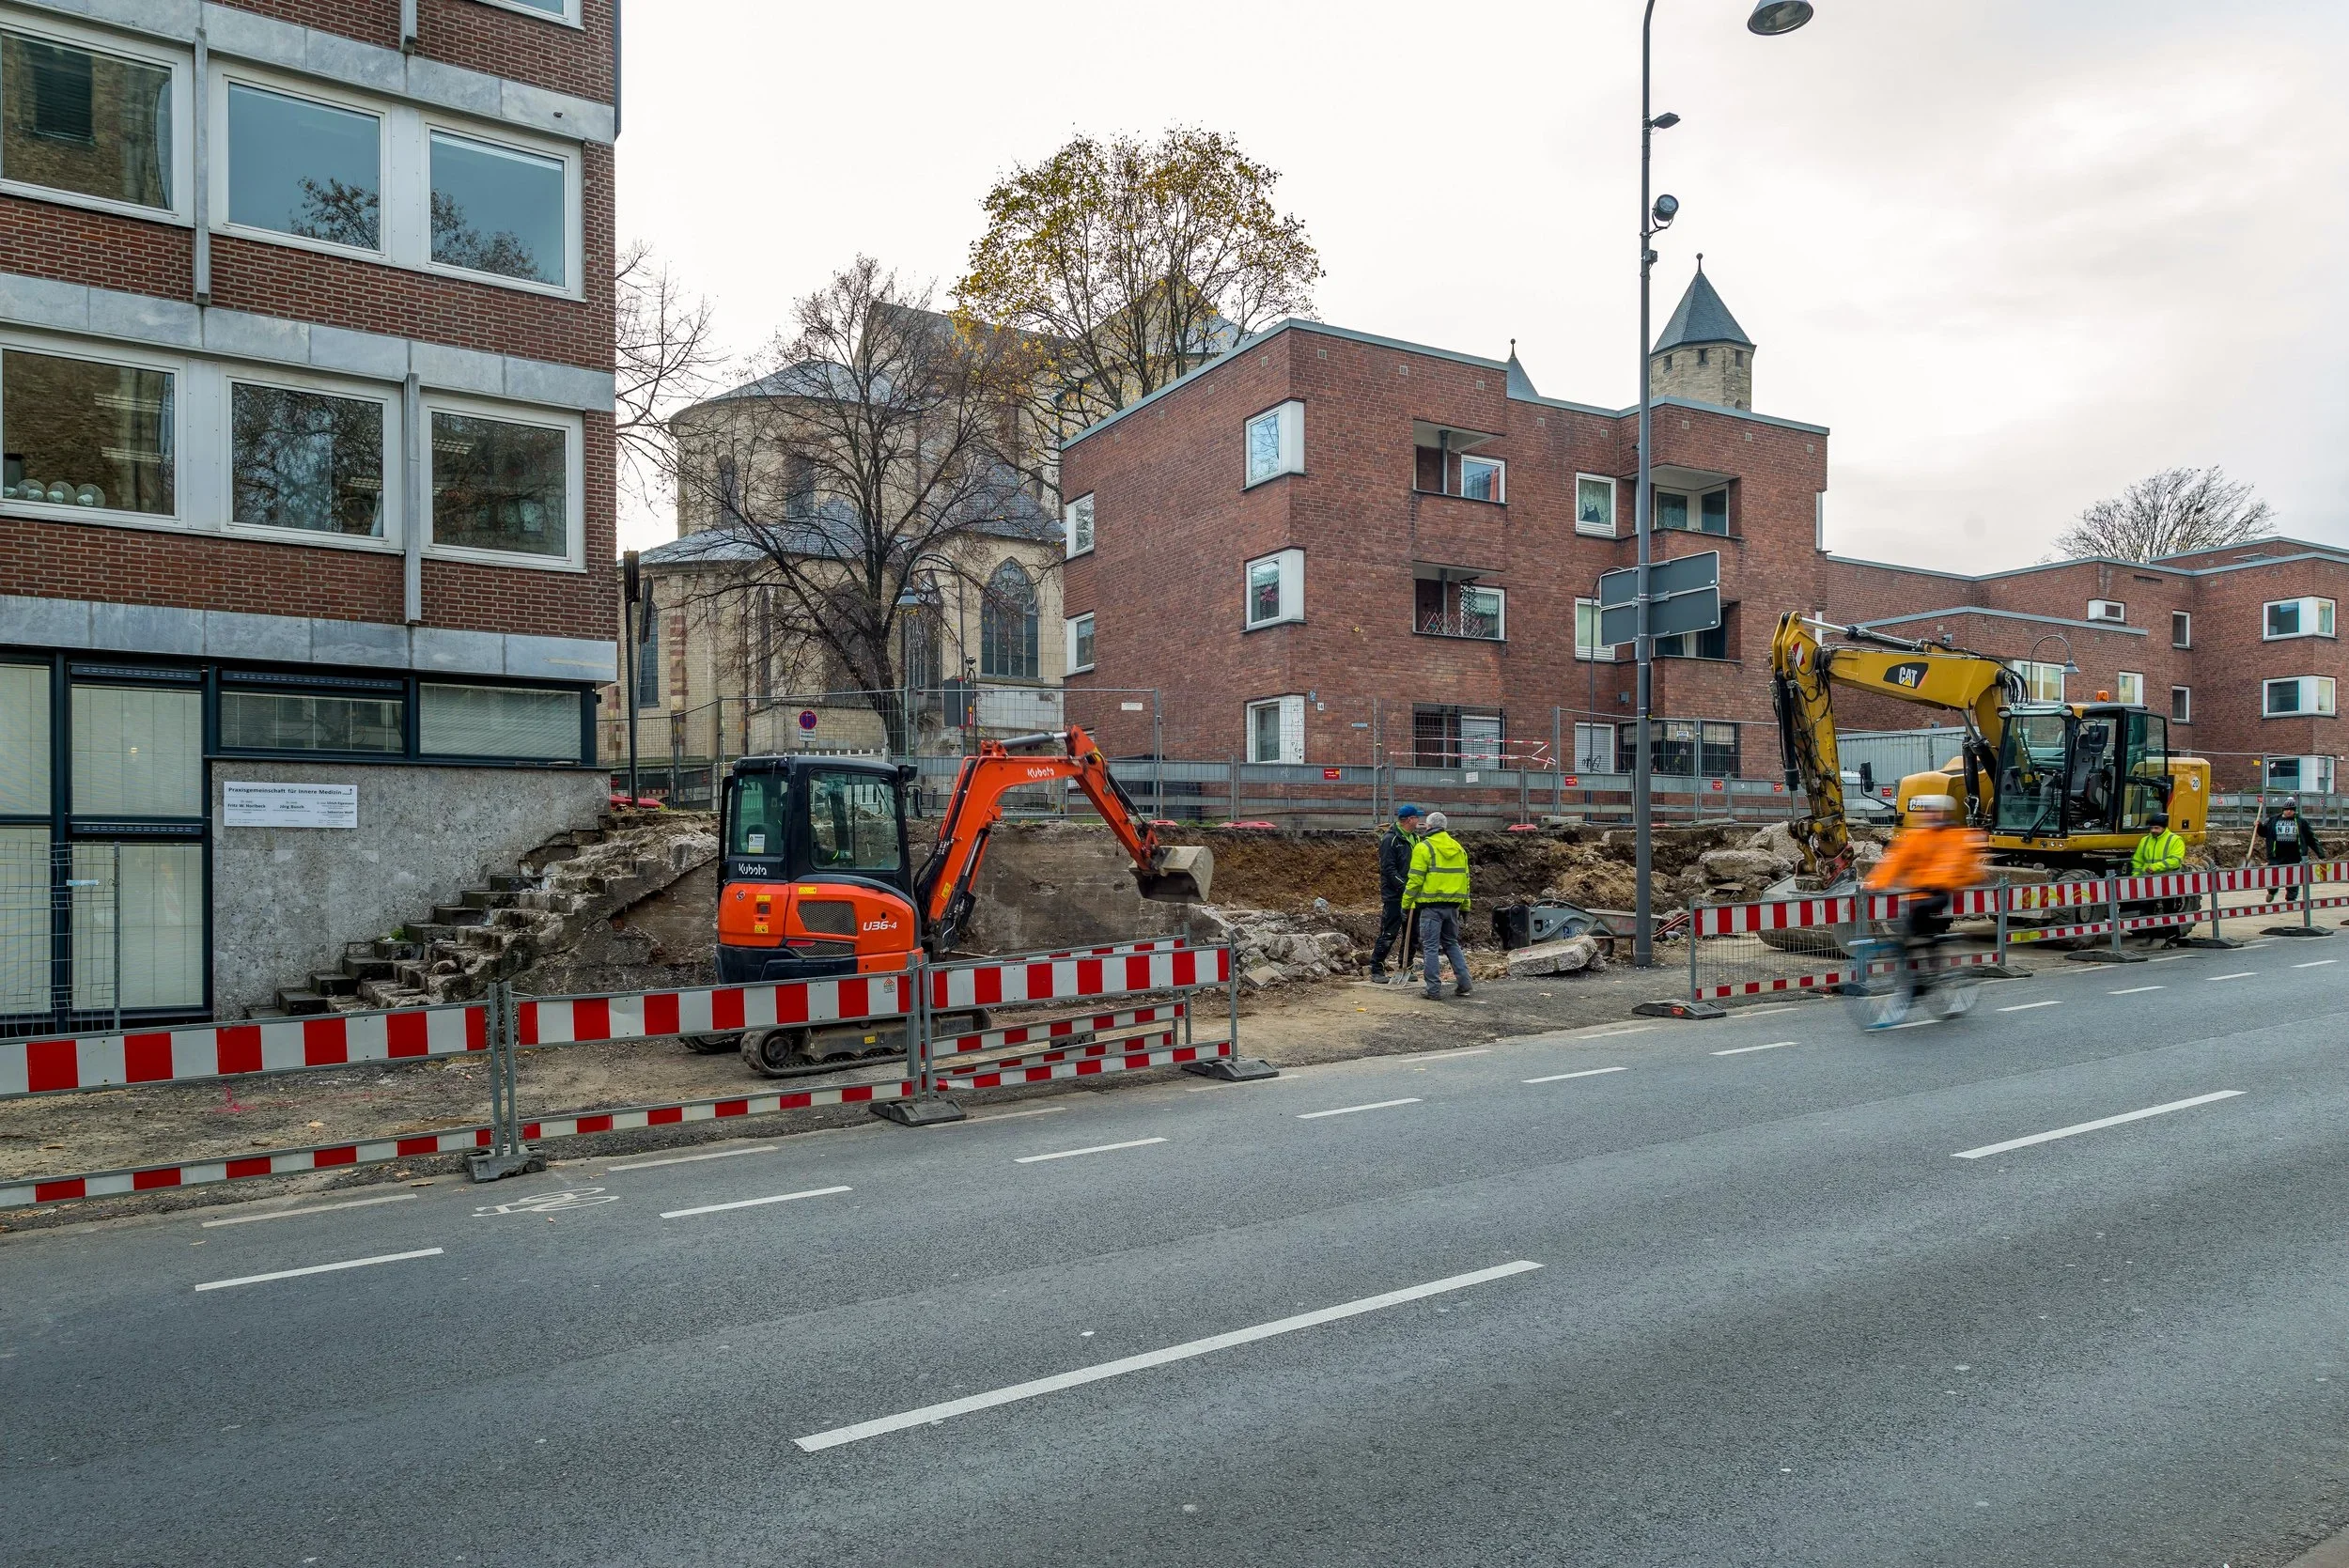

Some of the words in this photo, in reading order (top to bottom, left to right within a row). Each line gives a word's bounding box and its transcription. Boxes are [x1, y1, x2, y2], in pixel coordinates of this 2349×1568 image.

[1899, 666, 1917, 687] CAT
[1027, 766, 1054, 778] Kubota
[2192, 779, 2199, 788] 20
[738, 862, 768, 876] Kubota
[863, 920, 897, 931] U36-4
